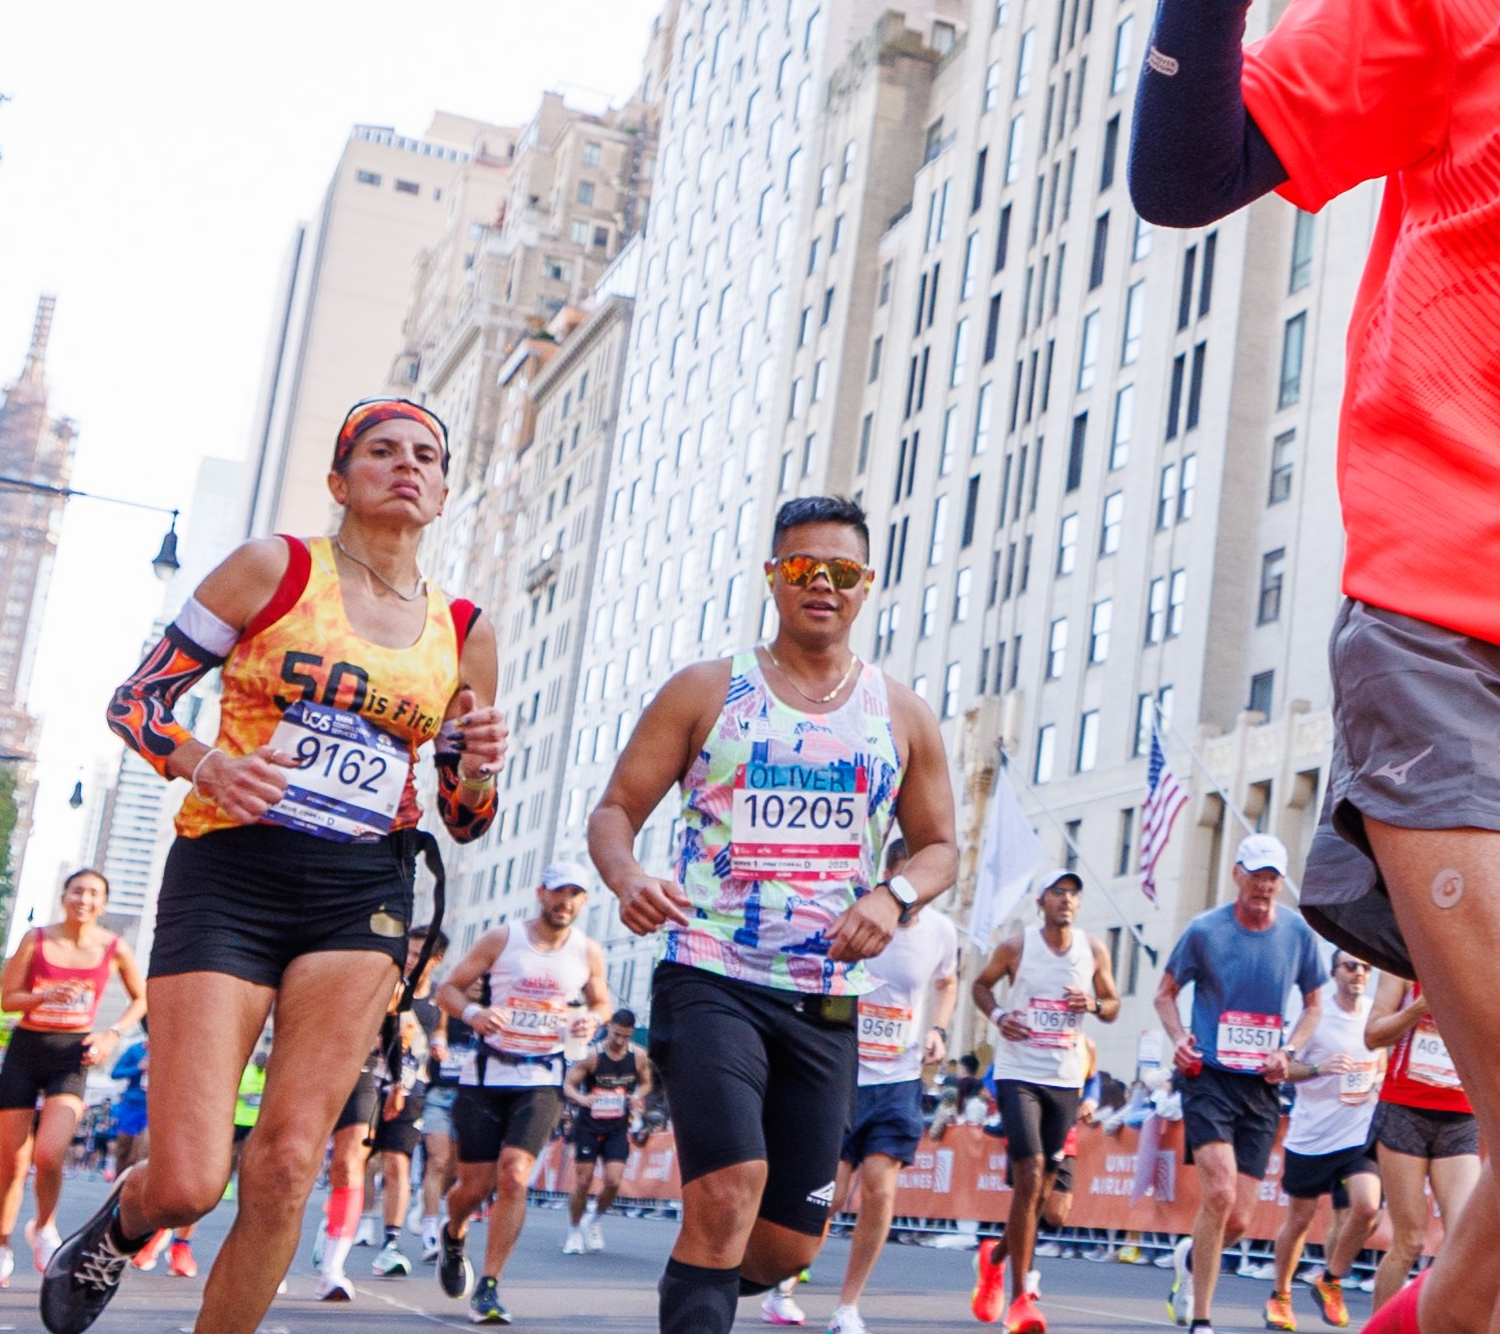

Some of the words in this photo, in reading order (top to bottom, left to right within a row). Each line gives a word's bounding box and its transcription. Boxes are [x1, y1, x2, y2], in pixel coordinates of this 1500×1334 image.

[272, 650, 369, 714] 50
[366, 688, 389, 716] is
[292, 735, 388, 795] 9162
[750, 765, 847, 793] OLIVER
[744, 794, 855, 829] 10205
[862, 1017, 903, 1039] 9561
[1032, 1010, 1076, 1028] 10676
[1227, 1027, 1273, 1047] 13551
[1105, 1154, 1140, 1173] UNIT
